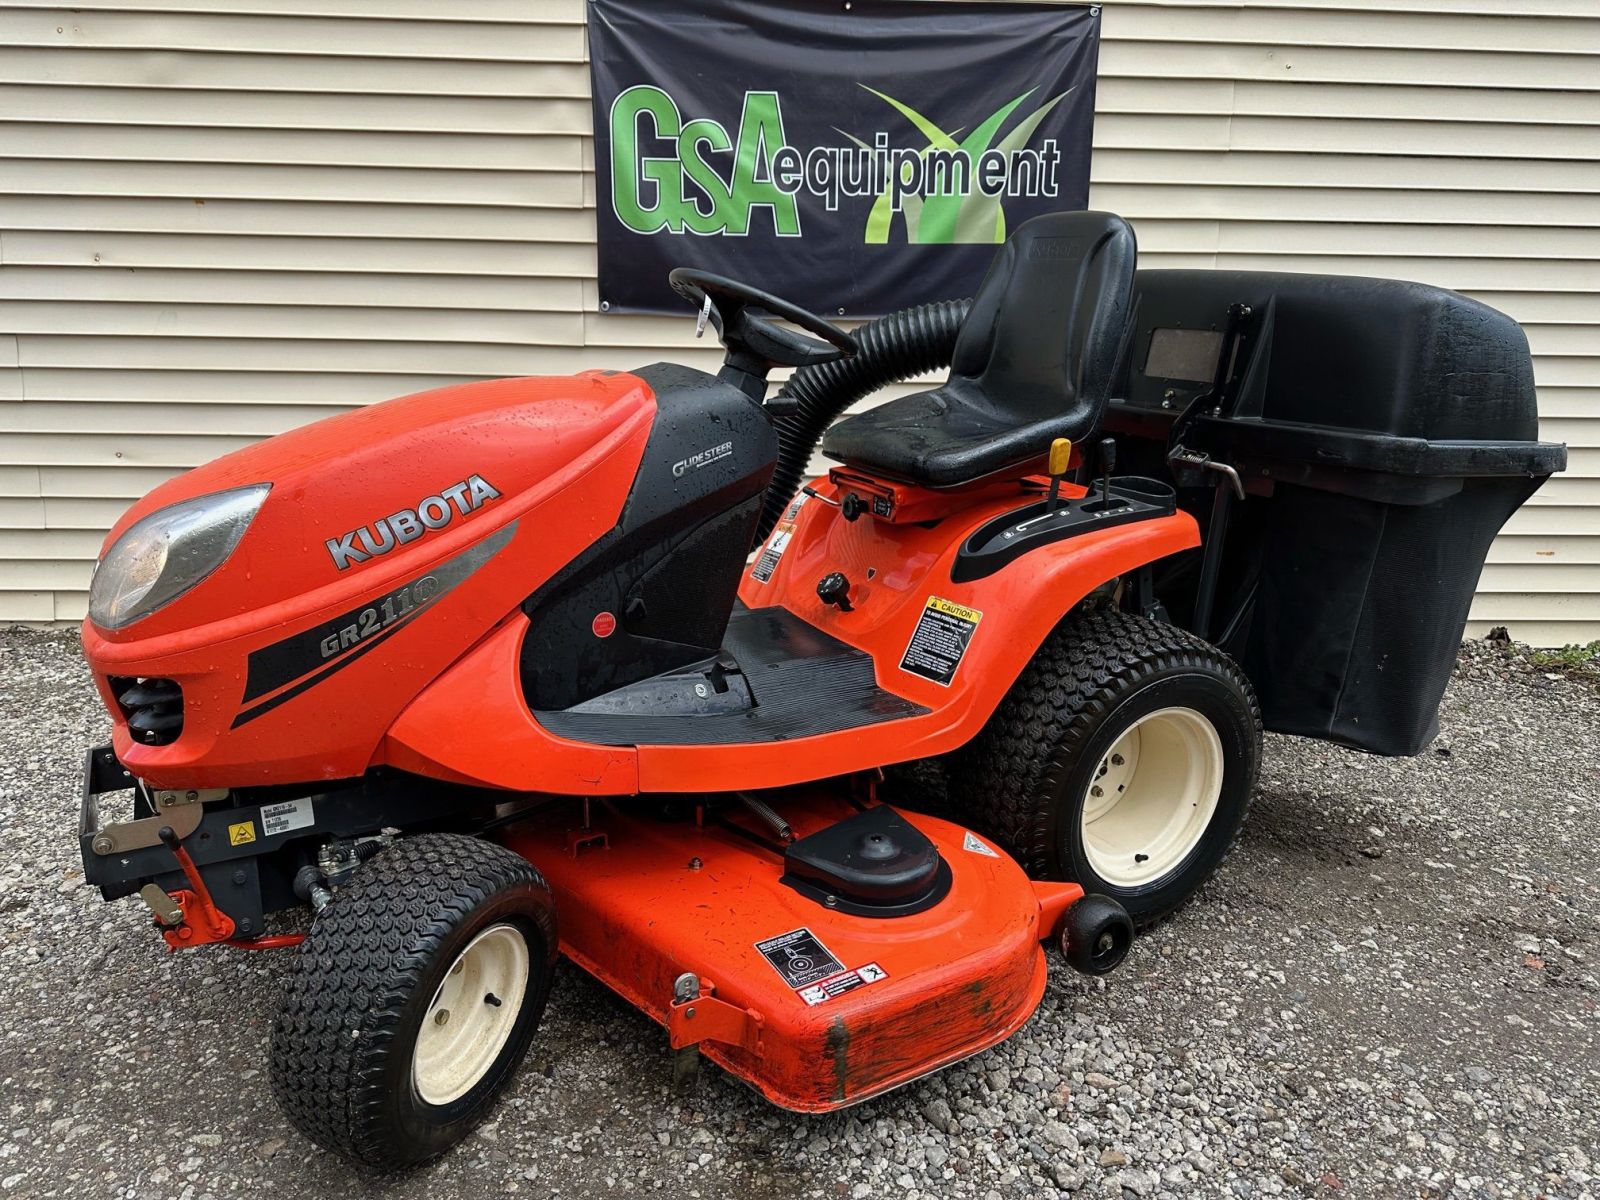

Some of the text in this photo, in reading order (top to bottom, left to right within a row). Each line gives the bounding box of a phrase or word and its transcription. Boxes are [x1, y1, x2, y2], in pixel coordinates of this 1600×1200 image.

[771, 131, 1061, 212] equipment
[672, 452, 704, 477] GLIDE
[704, 441, 733, 460] STEER
[325, 474, 503, 571] KUBOTA
[941, 603, 973, 618] CAUTION
